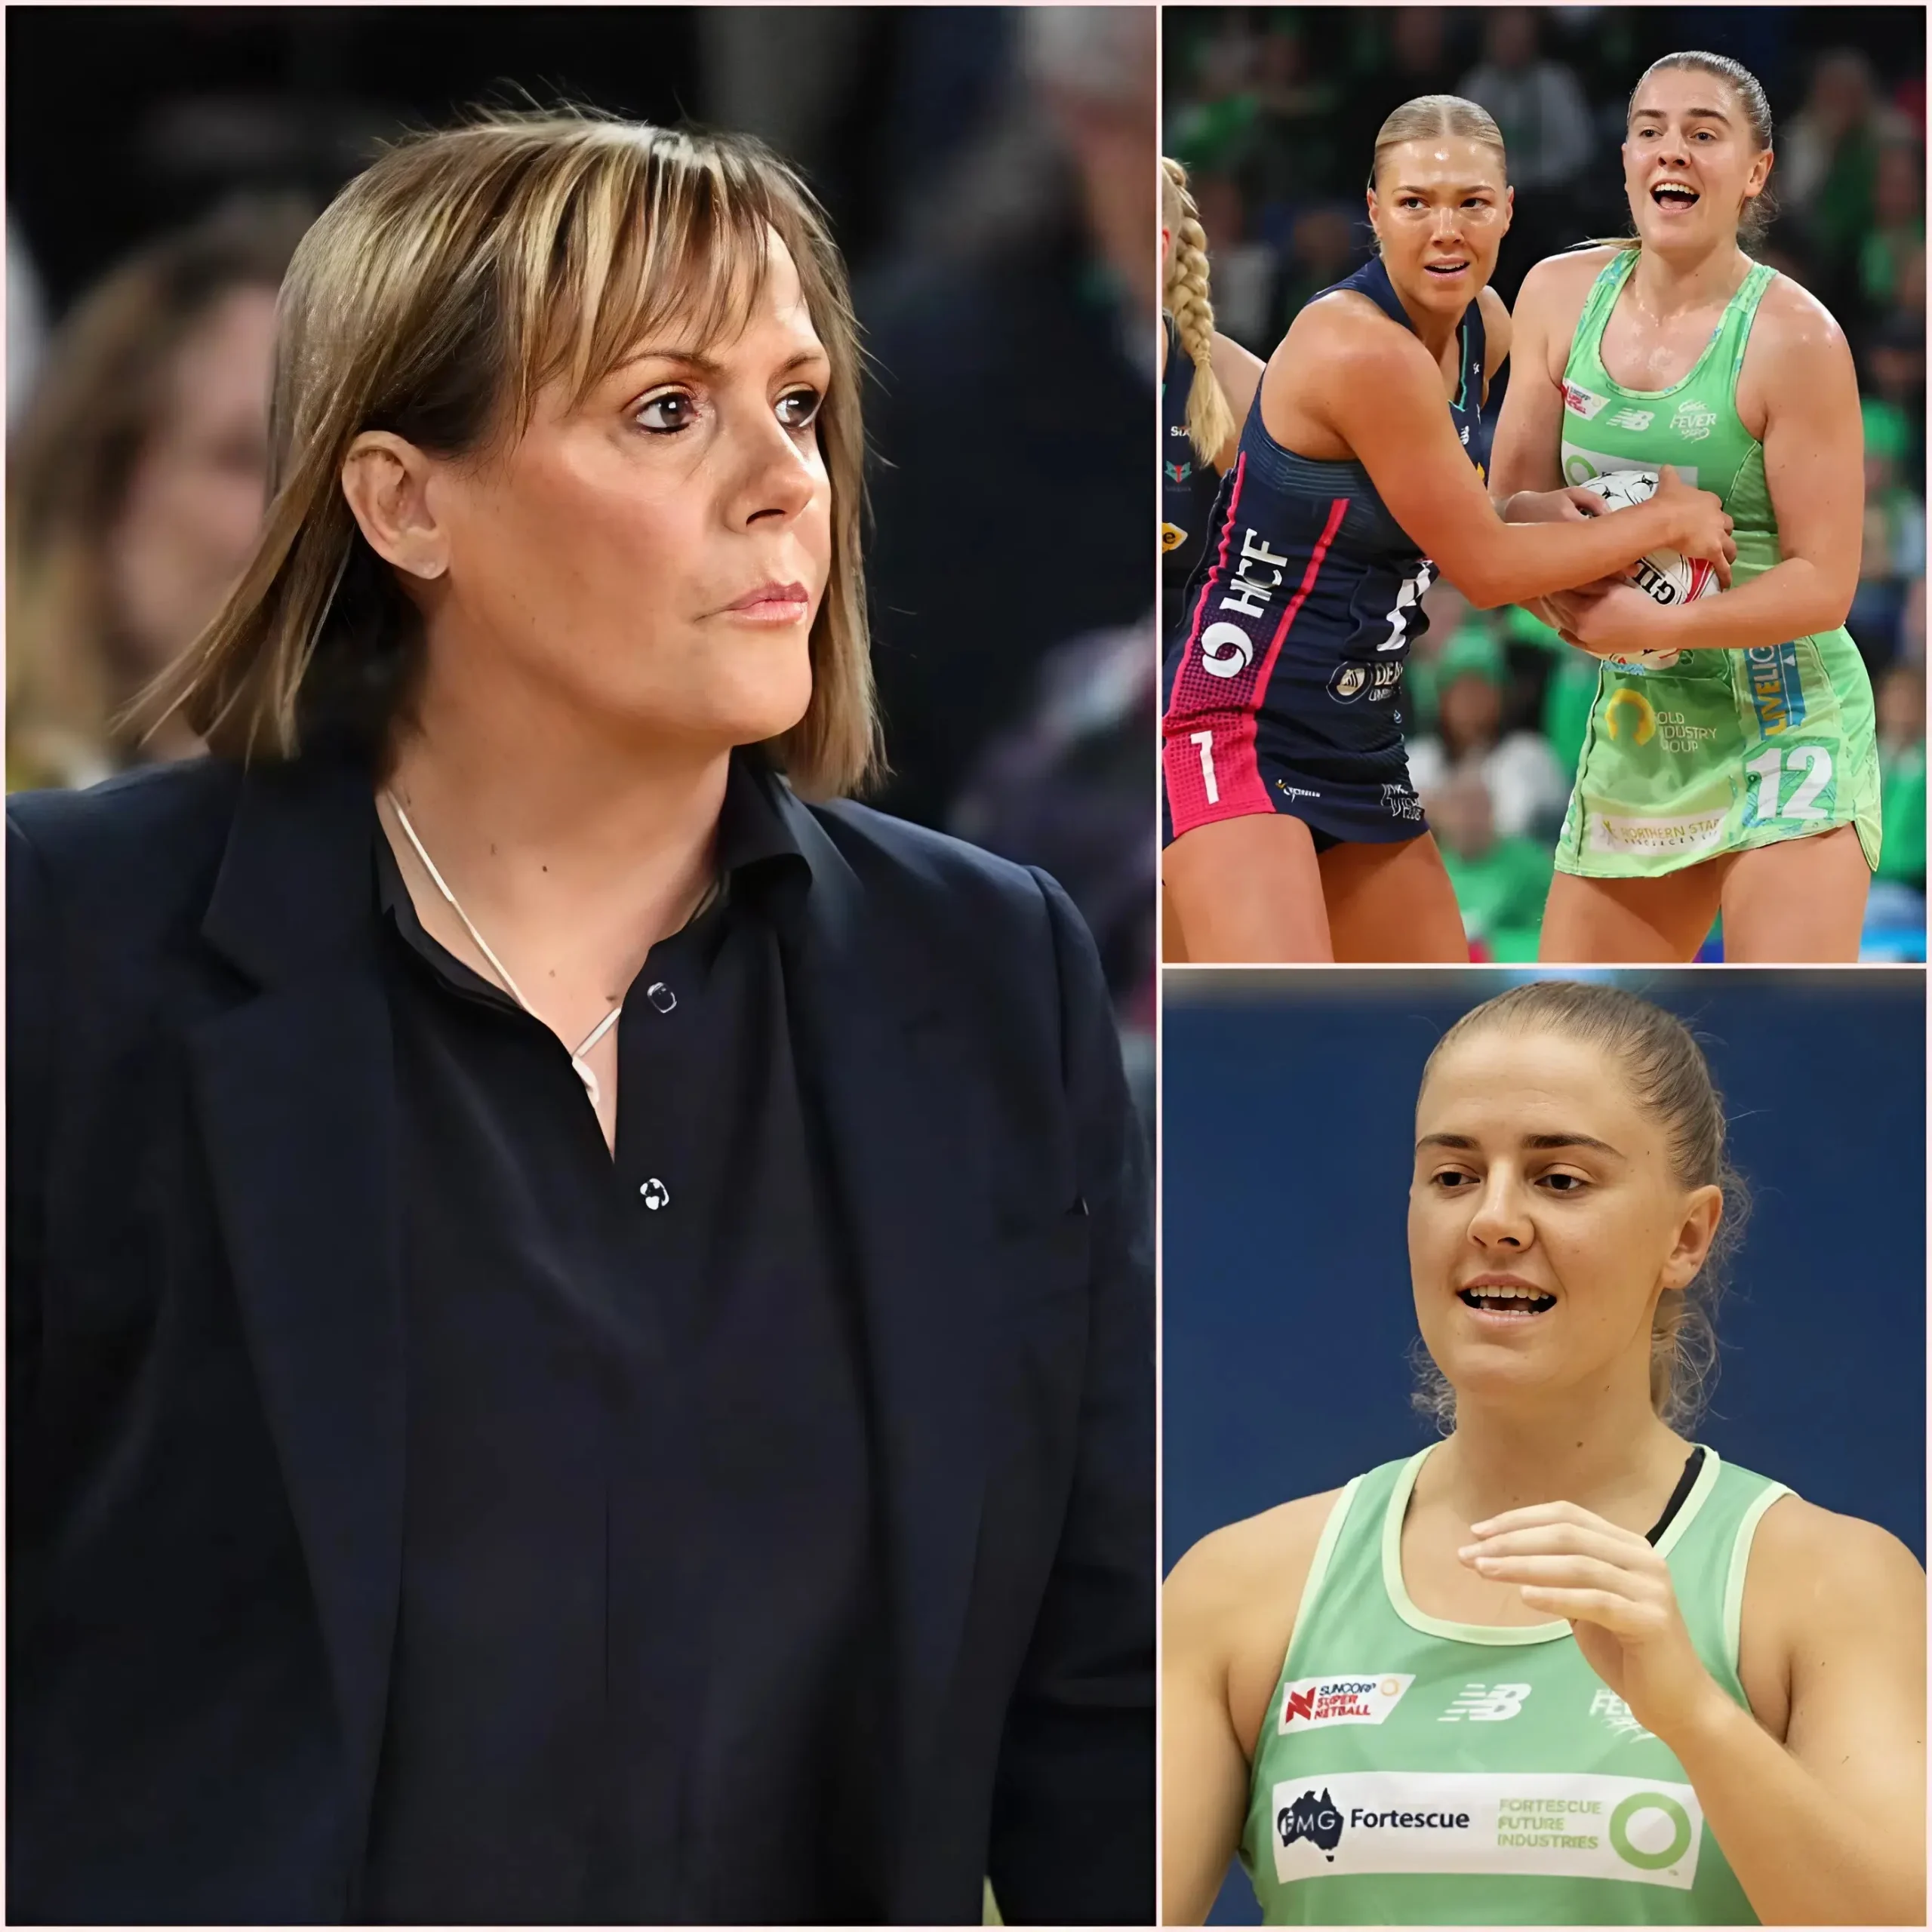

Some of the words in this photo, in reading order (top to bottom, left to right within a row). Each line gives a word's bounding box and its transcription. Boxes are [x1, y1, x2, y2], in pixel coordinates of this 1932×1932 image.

[1669, 413, 1717, 429] FEVER
[1219, 528, 1287, 619] HCF
[1374, 661, 1404, 686] DEA
[1657, 712, 1684, 724] OLD
[1746, 746, 1832, 820] 12
[1621, 826, 1685, 841] NORTHERN
[1314, 1704, 1371, 1719] NETBALL
[1499, 1798, 1602, 1814] FORTESCUE
[1350, 1808, 1470, 1829] Fortescue
[1497, 1816, 1564, 1831] FUTURE
[1497, 1833, 1598, 1850] INDUSTRIES
